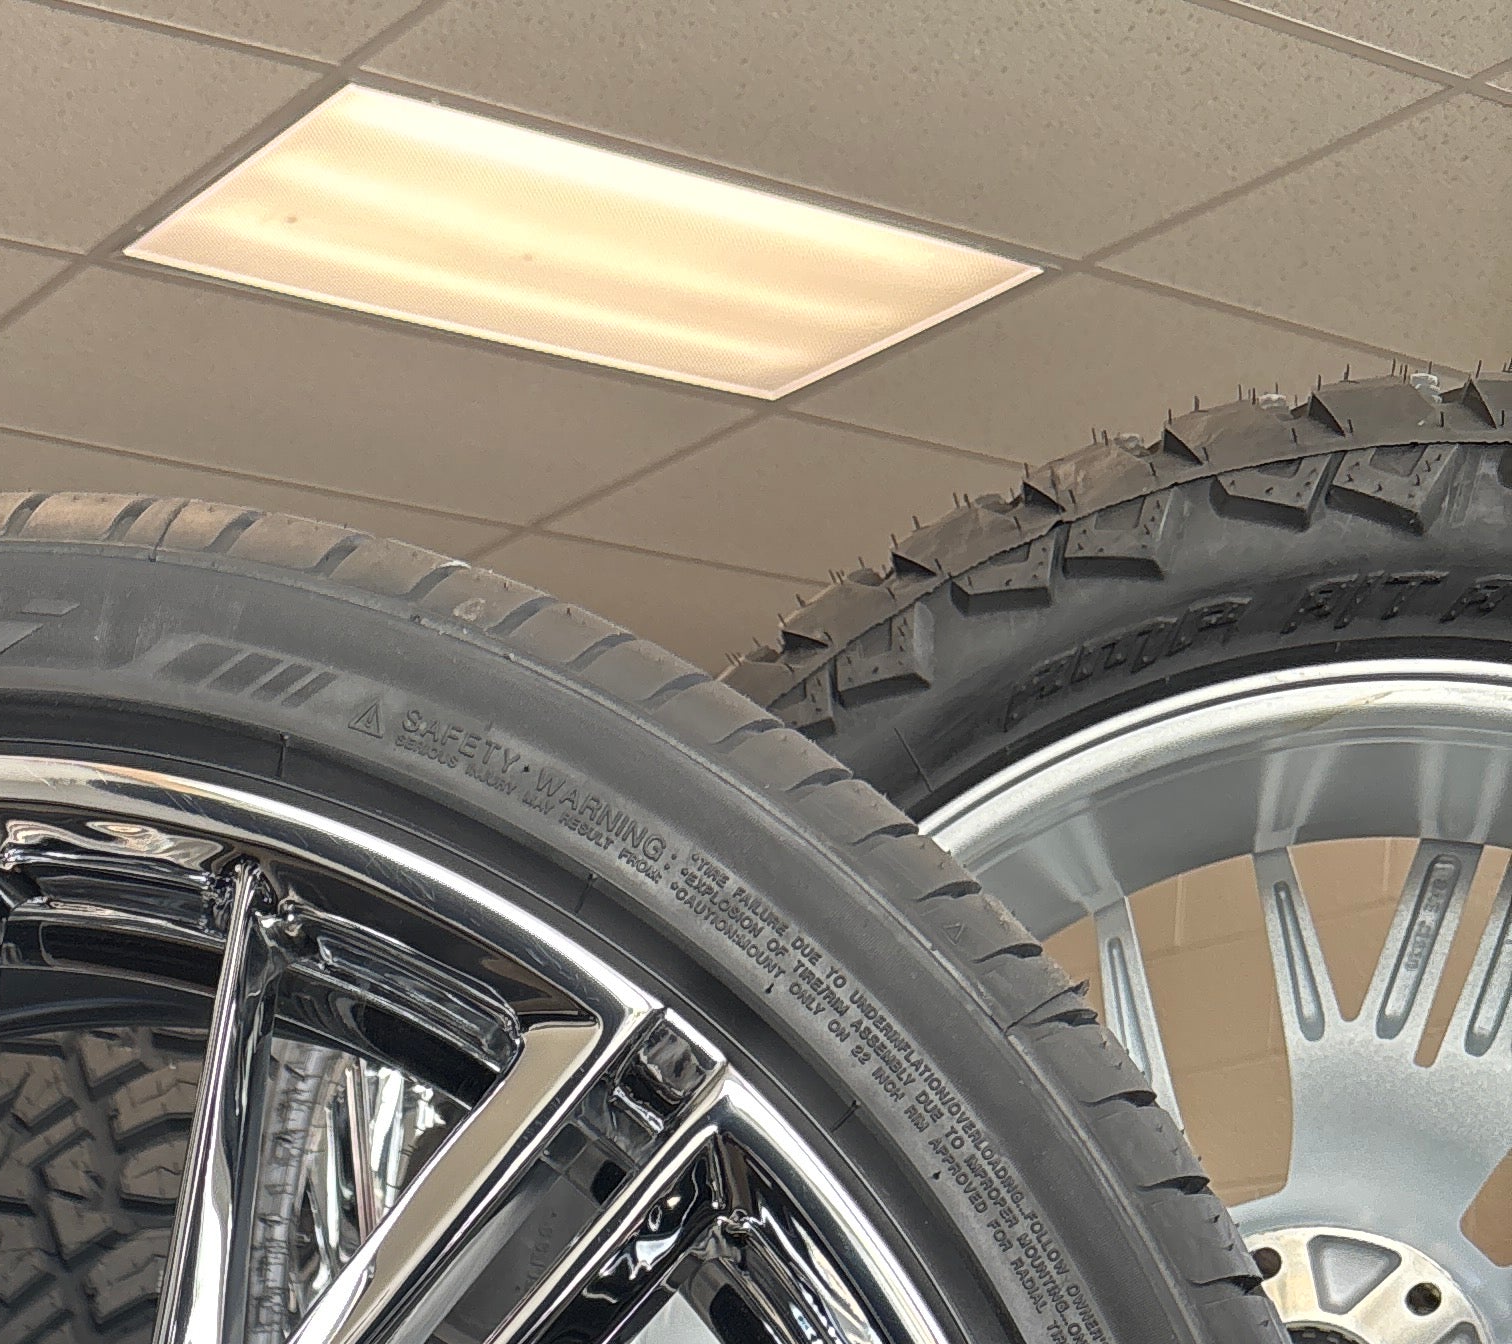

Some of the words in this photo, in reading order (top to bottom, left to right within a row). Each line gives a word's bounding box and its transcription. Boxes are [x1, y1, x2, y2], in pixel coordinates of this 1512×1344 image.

[392, 728, 462, 771] SERIOUS
[462, 759, 519, 798] INJURY
[520, 787, 556, 818] MAY
[556, 808, 616, 853] RESULT
[397, 702, 523, 780] SAFETY
[729, 882, 791, 939] FAILURE
[787, 932, 825, 969] DUE
[821, 964, 851, 994] TO
[761, 933, 792, 964] OF
[788, 957, 851, 1020] TIRE/RIM
[846, 1014, 917, 1091] ASSEMBLY
[911, 1087, 946, 1126] DUE
[939, 1123, 968, 1155] TO
[960, 1151, 1022, 1232] IMPROPER
[785, 977, 828, 1021] ONLY
[823, 1015, 853, 1045] ON
[847, 1040, 875, 1069] 22
[868, 1063, 907, 1105] INCH
[900, 1101, 932, 1135] RIM
[925, 1132, 992, 1217] APPROVED
[983, 1214, 1017, 1255] FOR
[1007, 1253, 1053, 1315] RADIAL
